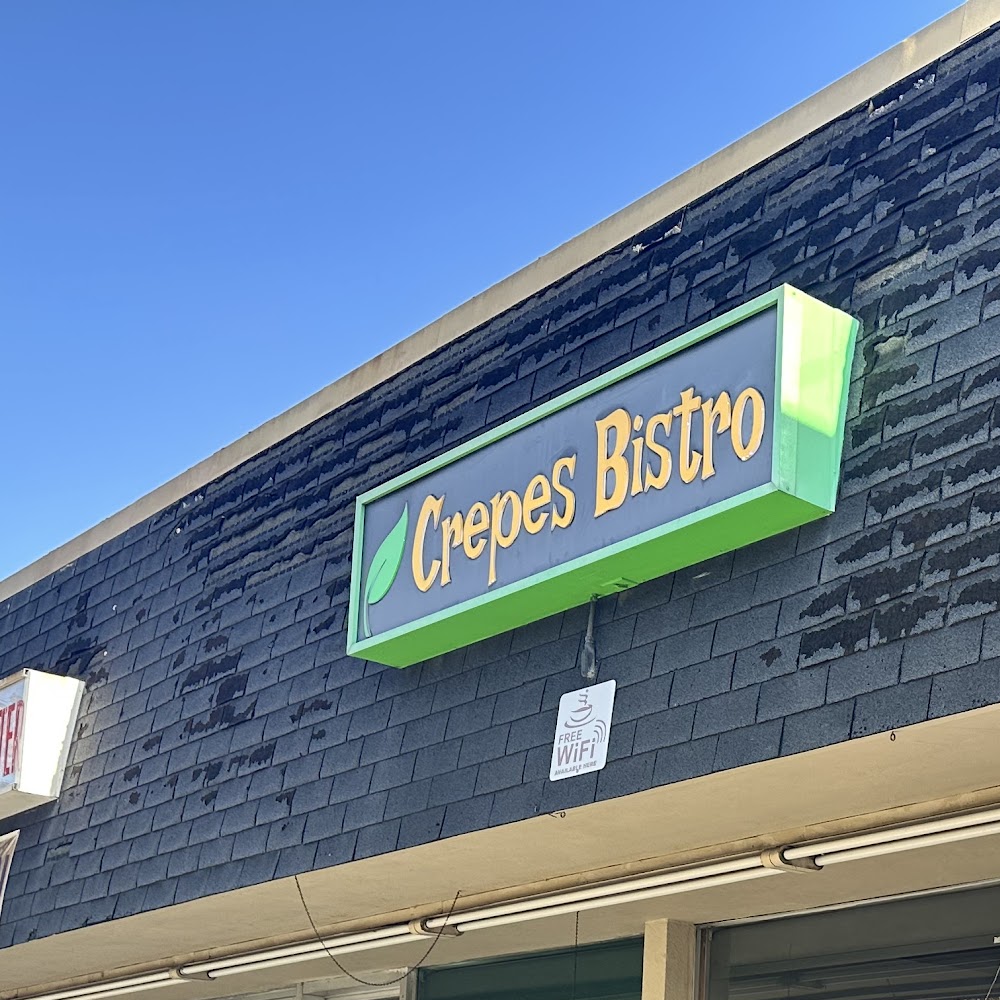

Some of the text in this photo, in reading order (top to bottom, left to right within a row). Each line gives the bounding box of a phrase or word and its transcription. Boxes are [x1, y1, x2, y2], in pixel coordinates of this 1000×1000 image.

[411, 386, 766, 594] Crepes Bistro
[558, 729, 583, 746] FREE
[557, 738, 596, 767] WiFi
[554, 760, 598, 776] AVAILABLE HERE
